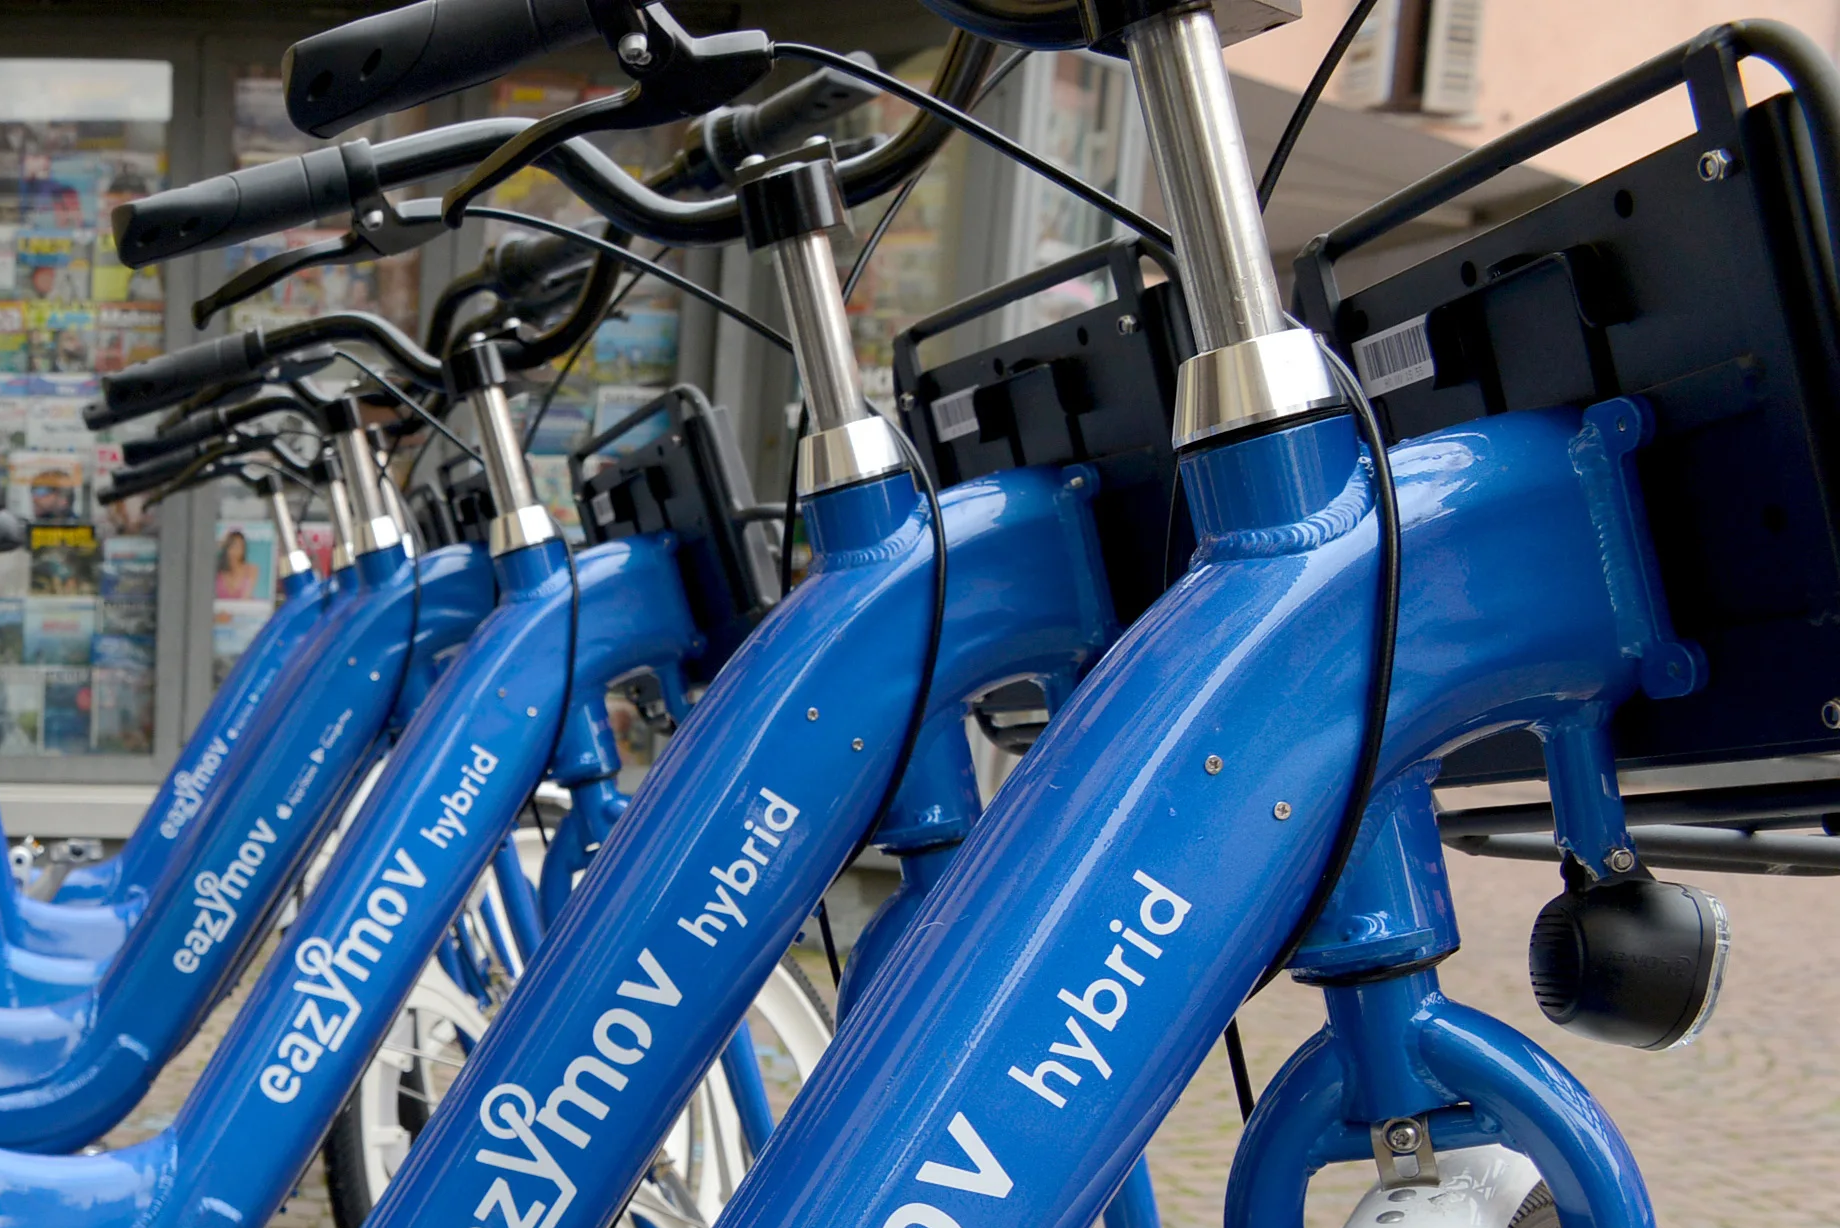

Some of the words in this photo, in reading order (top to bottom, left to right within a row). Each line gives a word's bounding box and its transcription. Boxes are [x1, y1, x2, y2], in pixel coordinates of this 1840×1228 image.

[160, 736, 229, 839] eazymov
[173, 816, 277, 973] eazymov
[261, 848, 427, 1102] eazymov
[421, 744, 498, 848] hybrid
[678, 788, 799, 946] hybrid
[1008, 870, 1191, 1108] hybrid
